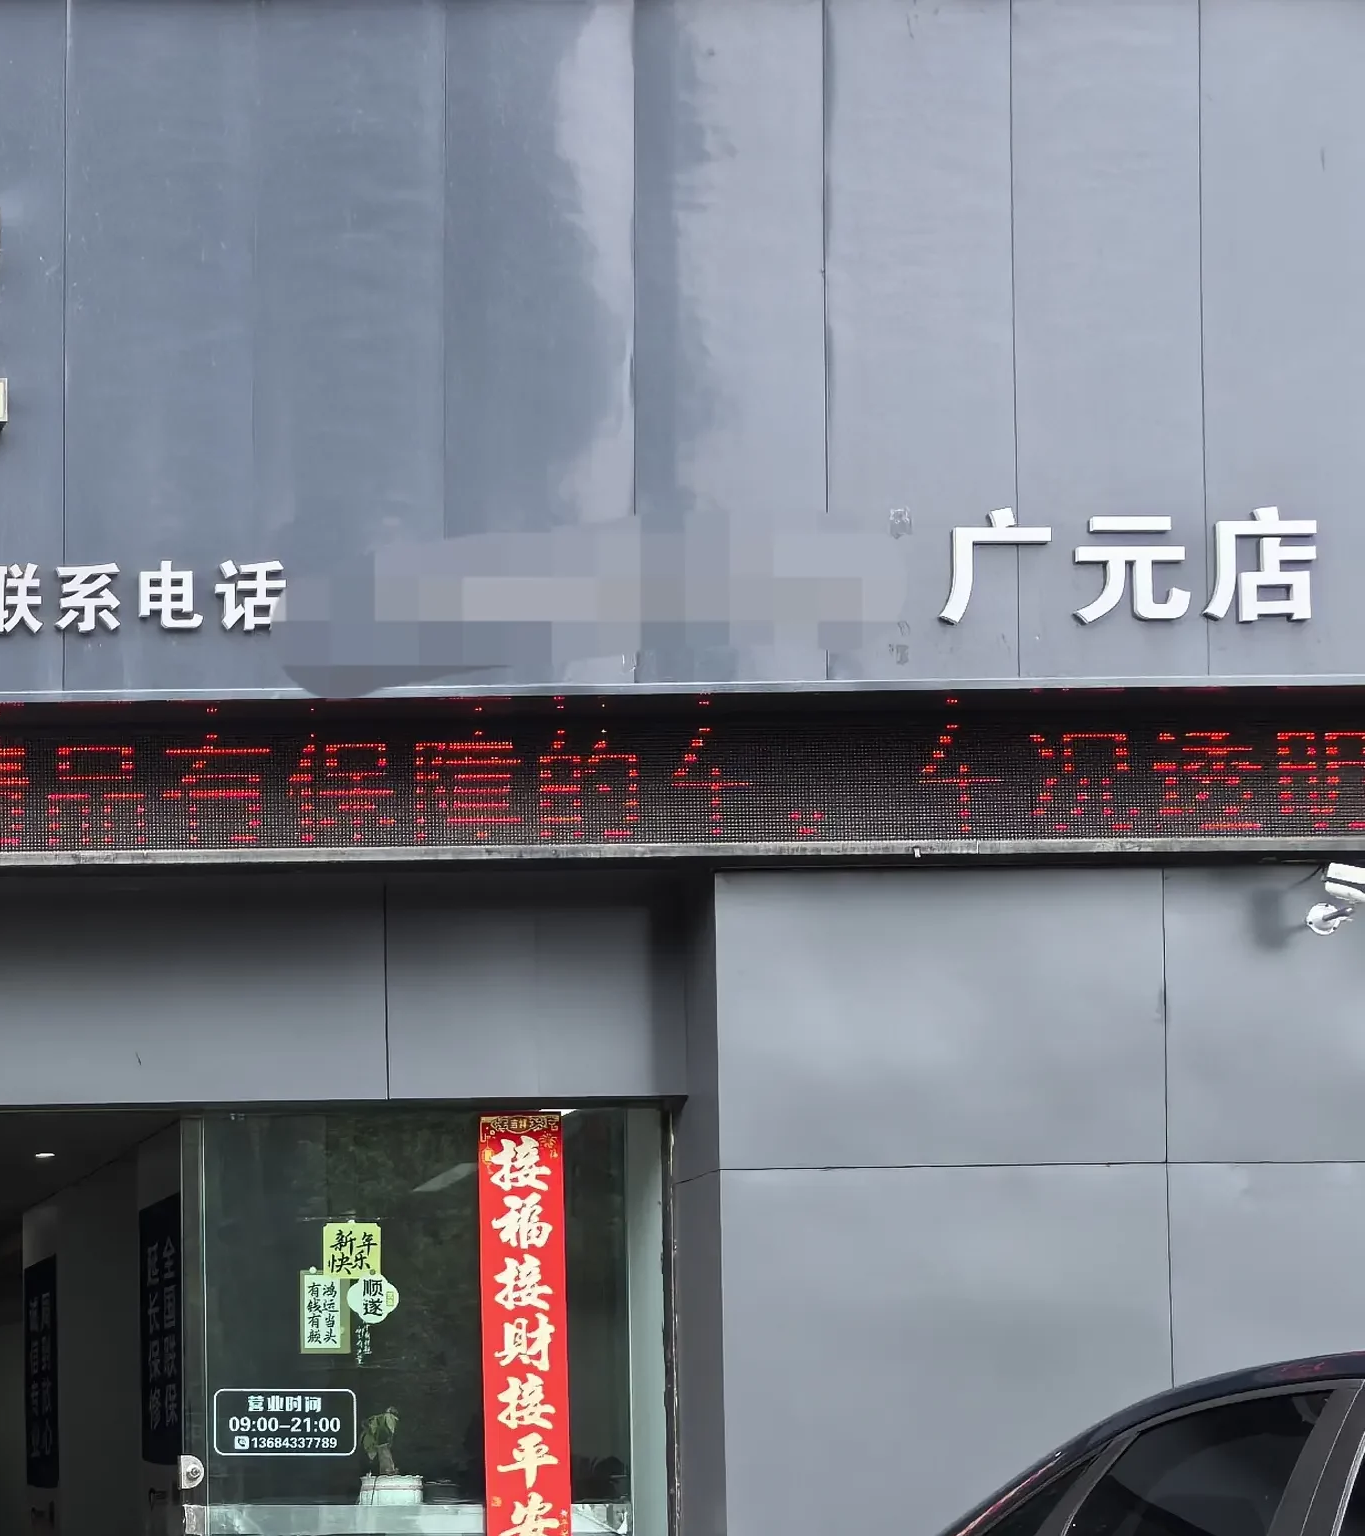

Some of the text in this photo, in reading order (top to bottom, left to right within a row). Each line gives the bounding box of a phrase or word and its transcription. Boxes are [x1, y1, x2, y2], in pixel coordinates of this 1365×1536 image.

[938, 504, 1318, 624] 广元店
[247, 1394, 322, 1413] 营业时间
